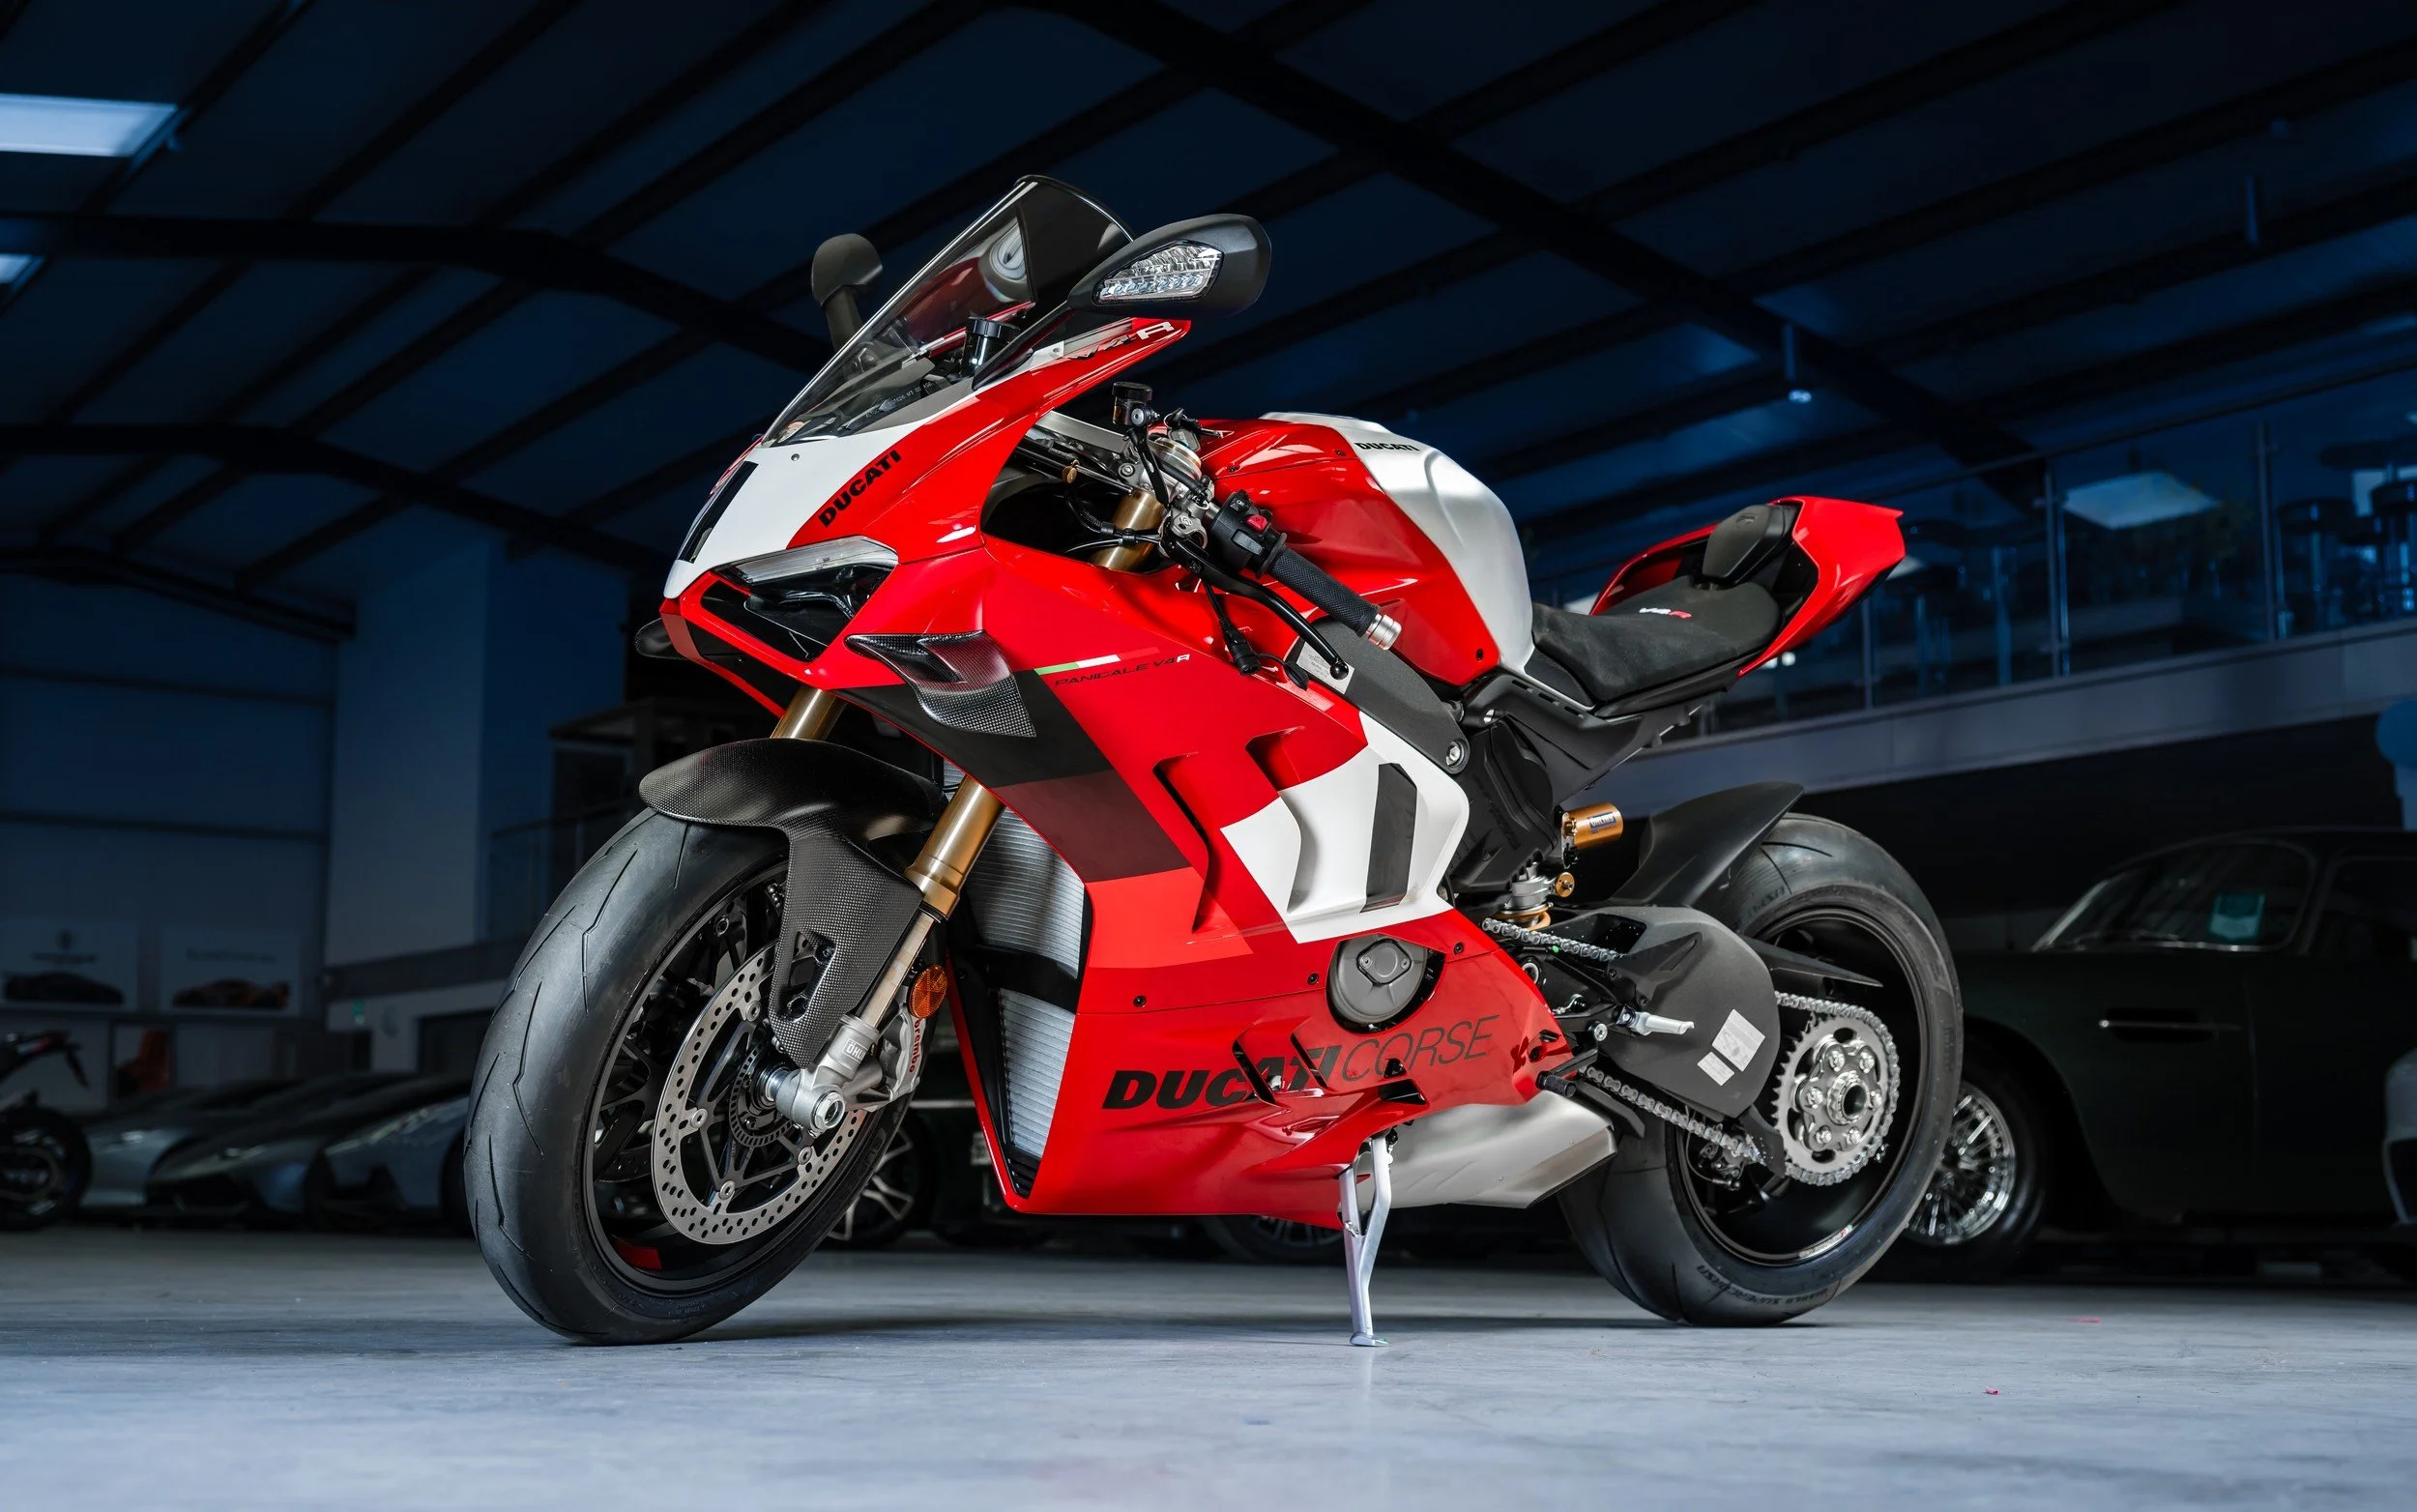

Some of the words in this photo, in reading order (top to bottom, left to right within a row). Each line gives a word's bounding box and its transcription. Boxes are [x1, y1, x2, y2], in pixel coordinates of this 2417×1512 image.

[1354, 442, 1420, 451] DUCATI
[818, 450, 902, 528] DUCATI
[1055, 662, 1149, 686] PANIGALE
[1153, 654, 1190, 667] V4R
[909, 1018, 921, 1073] brembo
[1102, 1044, 1342, 1109] DUCATI
[1342, 1015, 1500, 1082] CORSE
